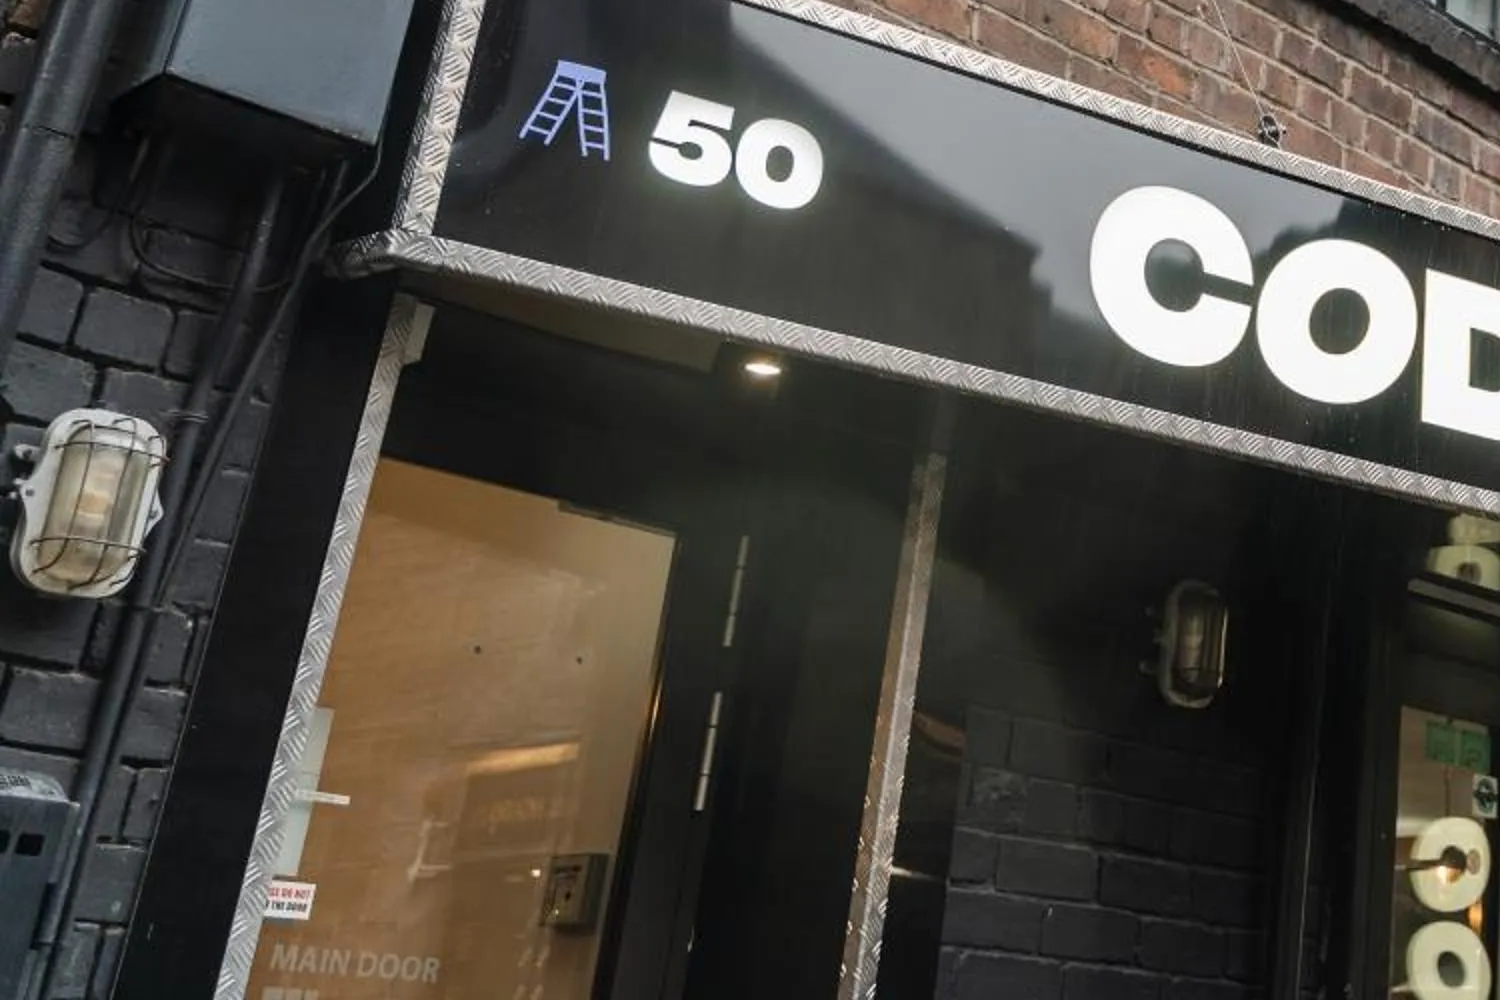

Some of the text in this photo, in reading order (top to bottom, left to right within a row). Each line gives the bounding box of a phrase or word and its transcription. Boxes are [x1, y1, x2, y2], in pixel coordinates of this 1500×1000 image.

[648, 90, 824, 209] 50
[270, 943, 441, 984] MAIN DOOR
